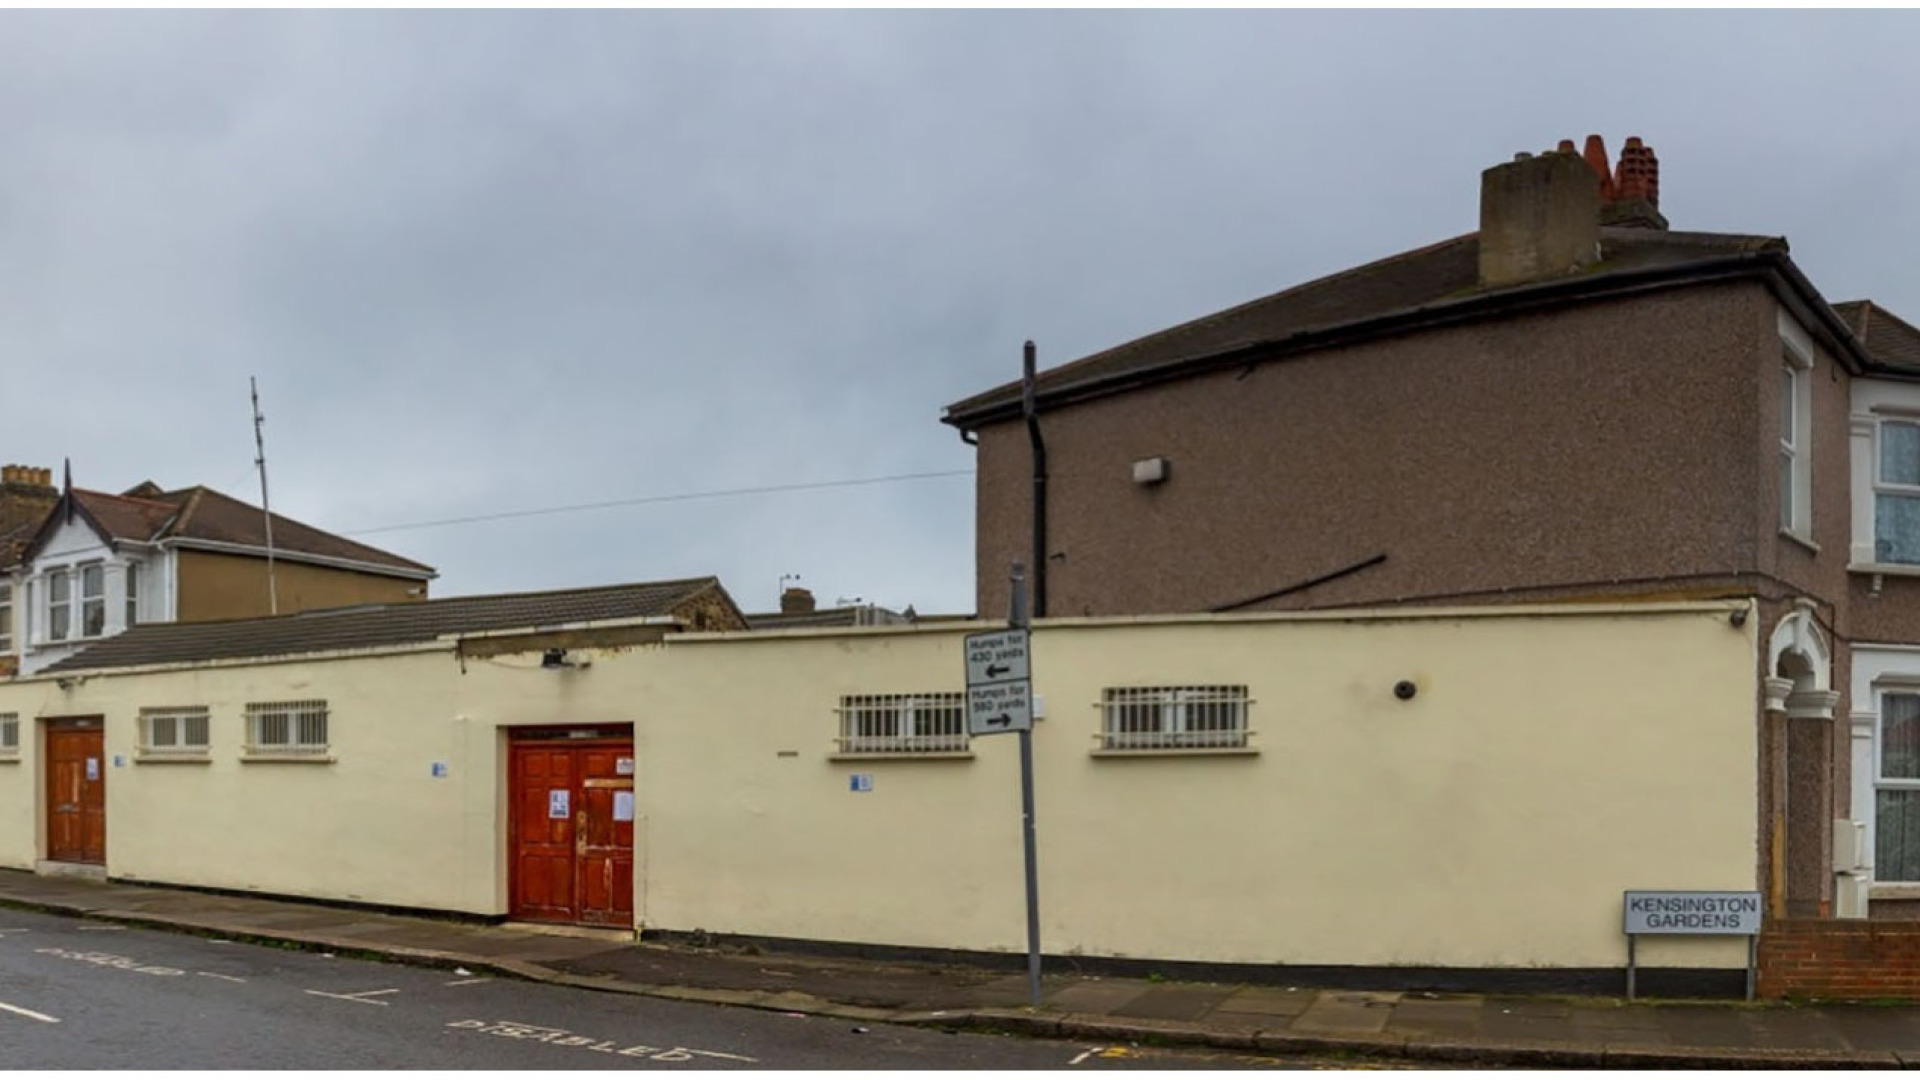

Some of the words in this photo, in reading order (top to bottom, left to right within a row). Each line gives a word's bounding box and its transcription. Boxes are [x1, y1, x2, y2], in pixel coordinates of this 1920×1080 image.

[970, 638, 1005, 650] Humps
[1007, 634, 1023, 645] for
[995, 648, 1024, 660] yards
[971, 688, 1006, 699] Humps
[1008, 685, 1026, 696] for
[996, 699, 1026, 711] yards
[1630, 898, 1757, 912] KENSINGTON
[1646, 914, 1741, 928] GARDENS
